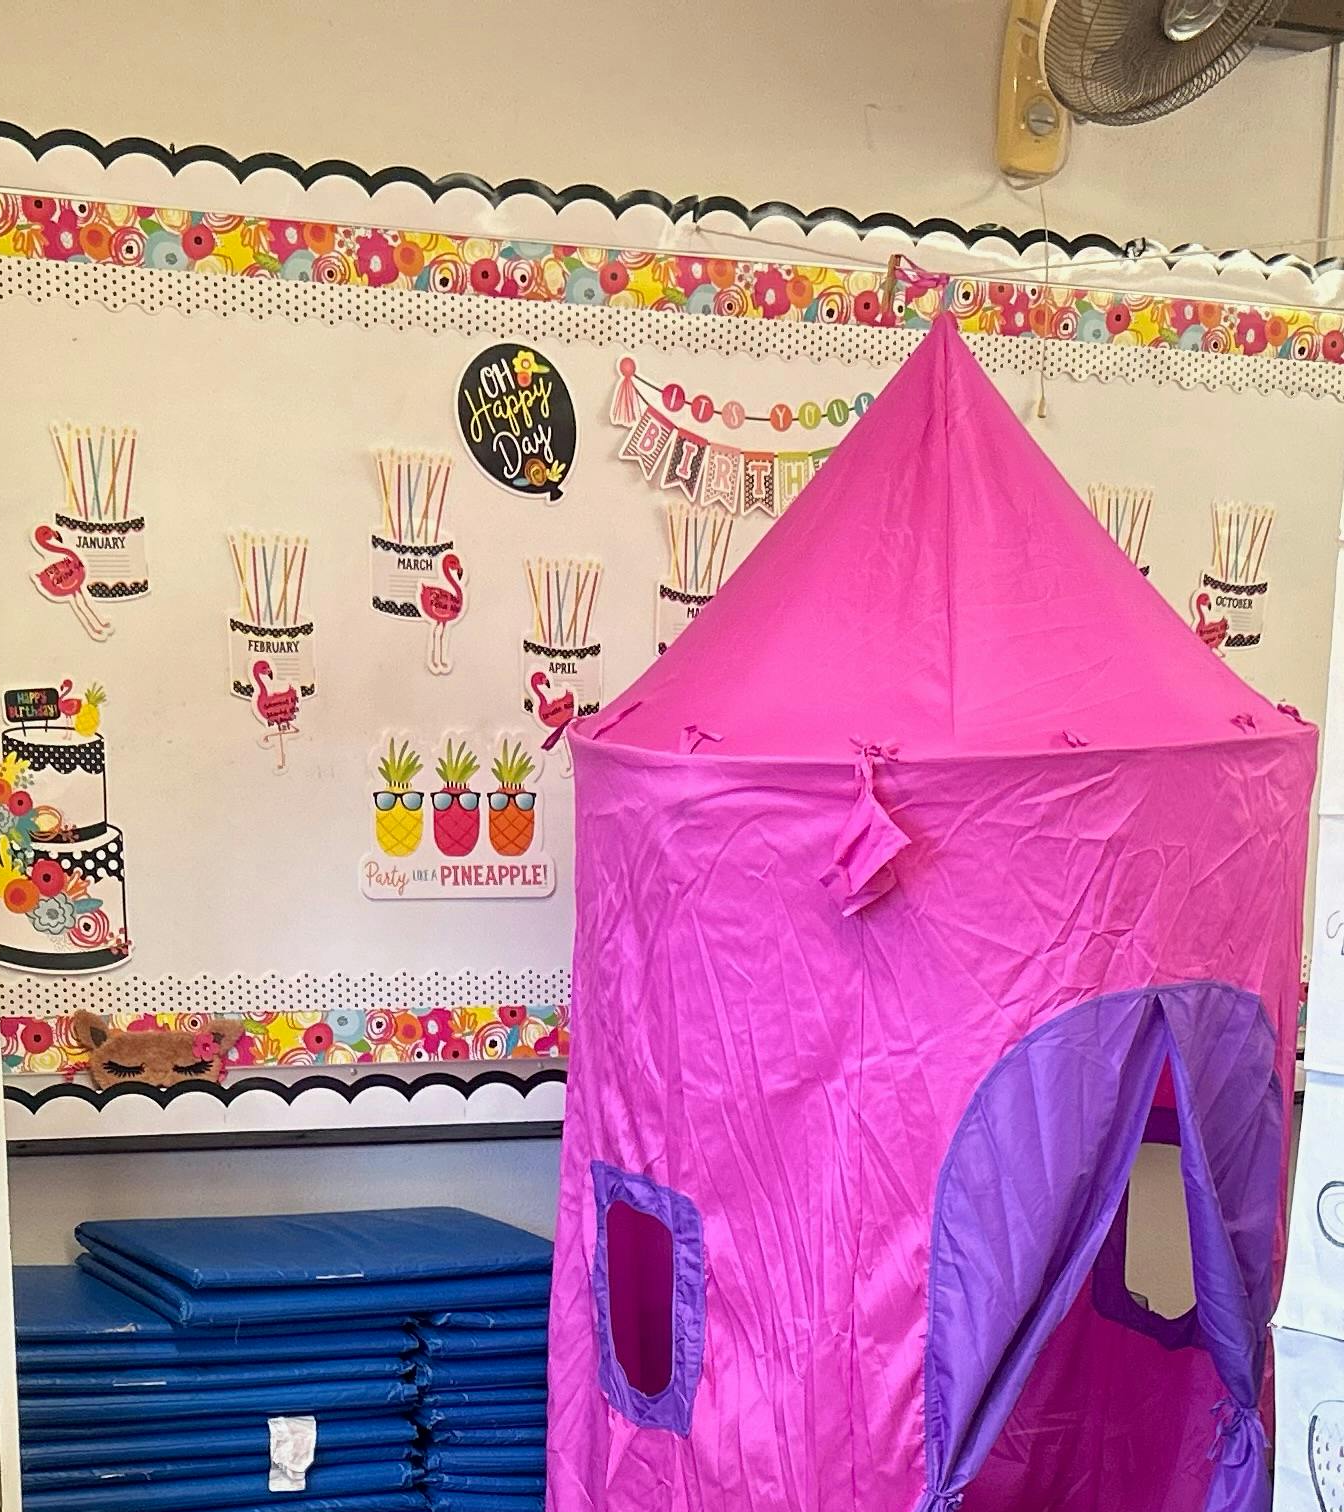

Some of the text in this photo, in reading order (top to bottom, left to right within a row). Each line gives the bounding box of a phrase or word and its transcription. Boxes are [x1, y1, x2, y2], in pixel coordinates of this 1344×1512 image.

[479, 358, 516, 399] OH
[464, 377, 553, 443] Happy
[493, 424, 554, 479] Day
[76, 536, 126, 550] JANUARY
[397, 557, 433, 571] MARCH
[1215, 595, 1253, 610] OCTOBER
[247, 639, 300, 654] FEBRUARY
[548, 661, 578, 675] APRIL
[364, 860, 548, 897] Party LIKE A PINEAPPLE!
